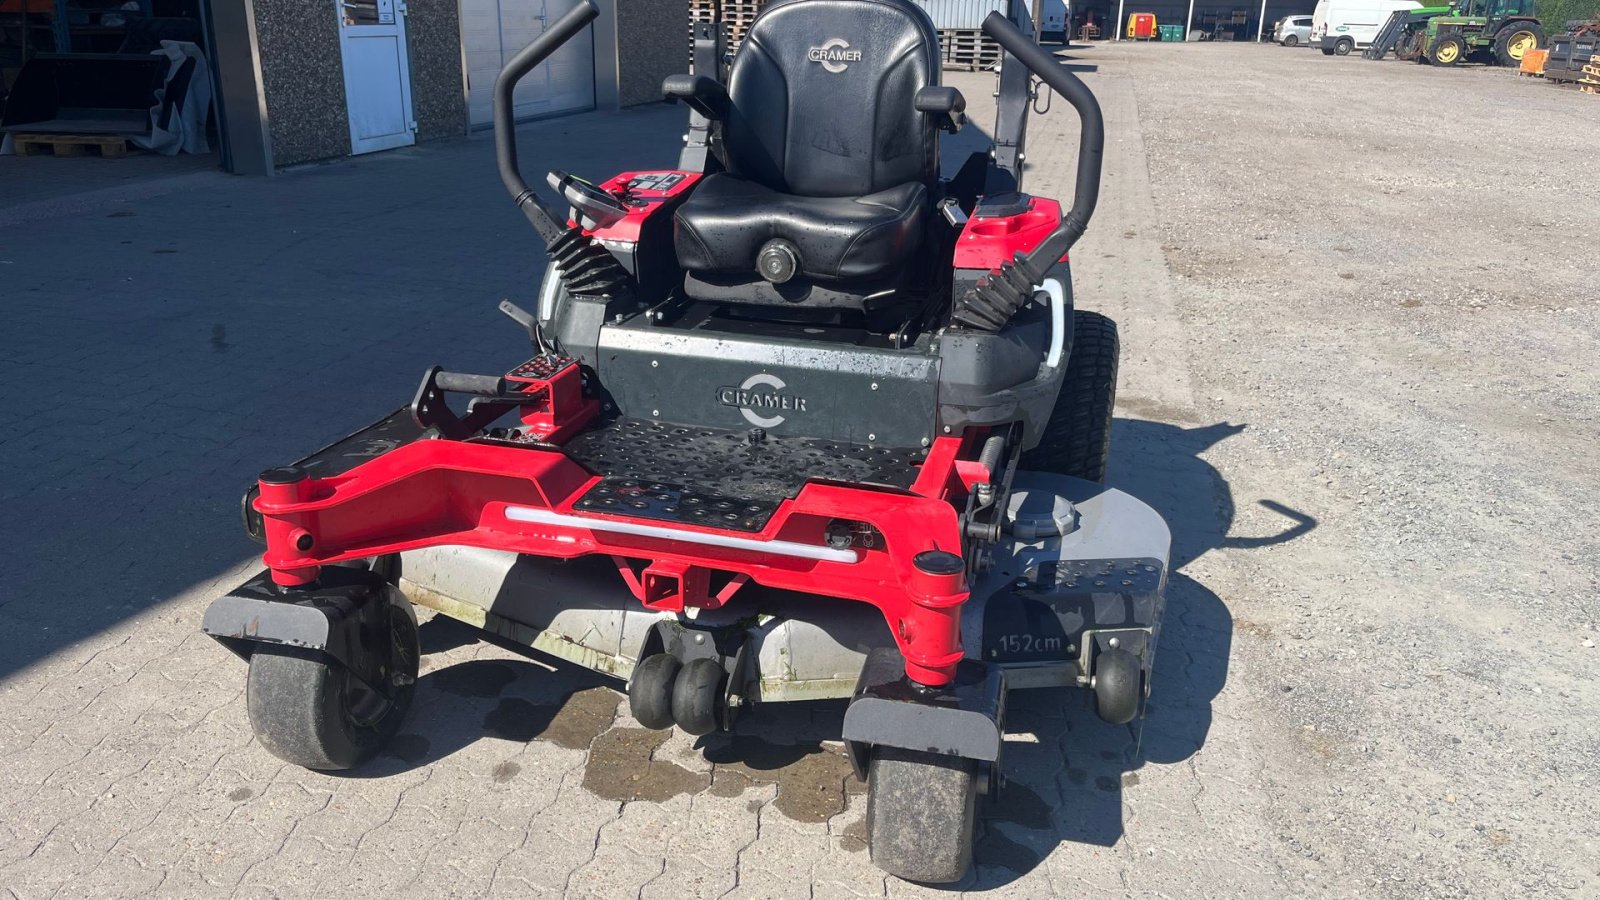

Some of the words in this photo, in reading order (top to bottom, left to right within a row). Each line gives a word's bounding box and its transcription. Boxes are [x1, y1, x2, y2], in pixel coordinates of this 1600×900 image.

[810, 50, 862, 61] CRAMER
[721, 390, 806, 411] CRAMER
[1000, 634, 1061, 653] 152cm
